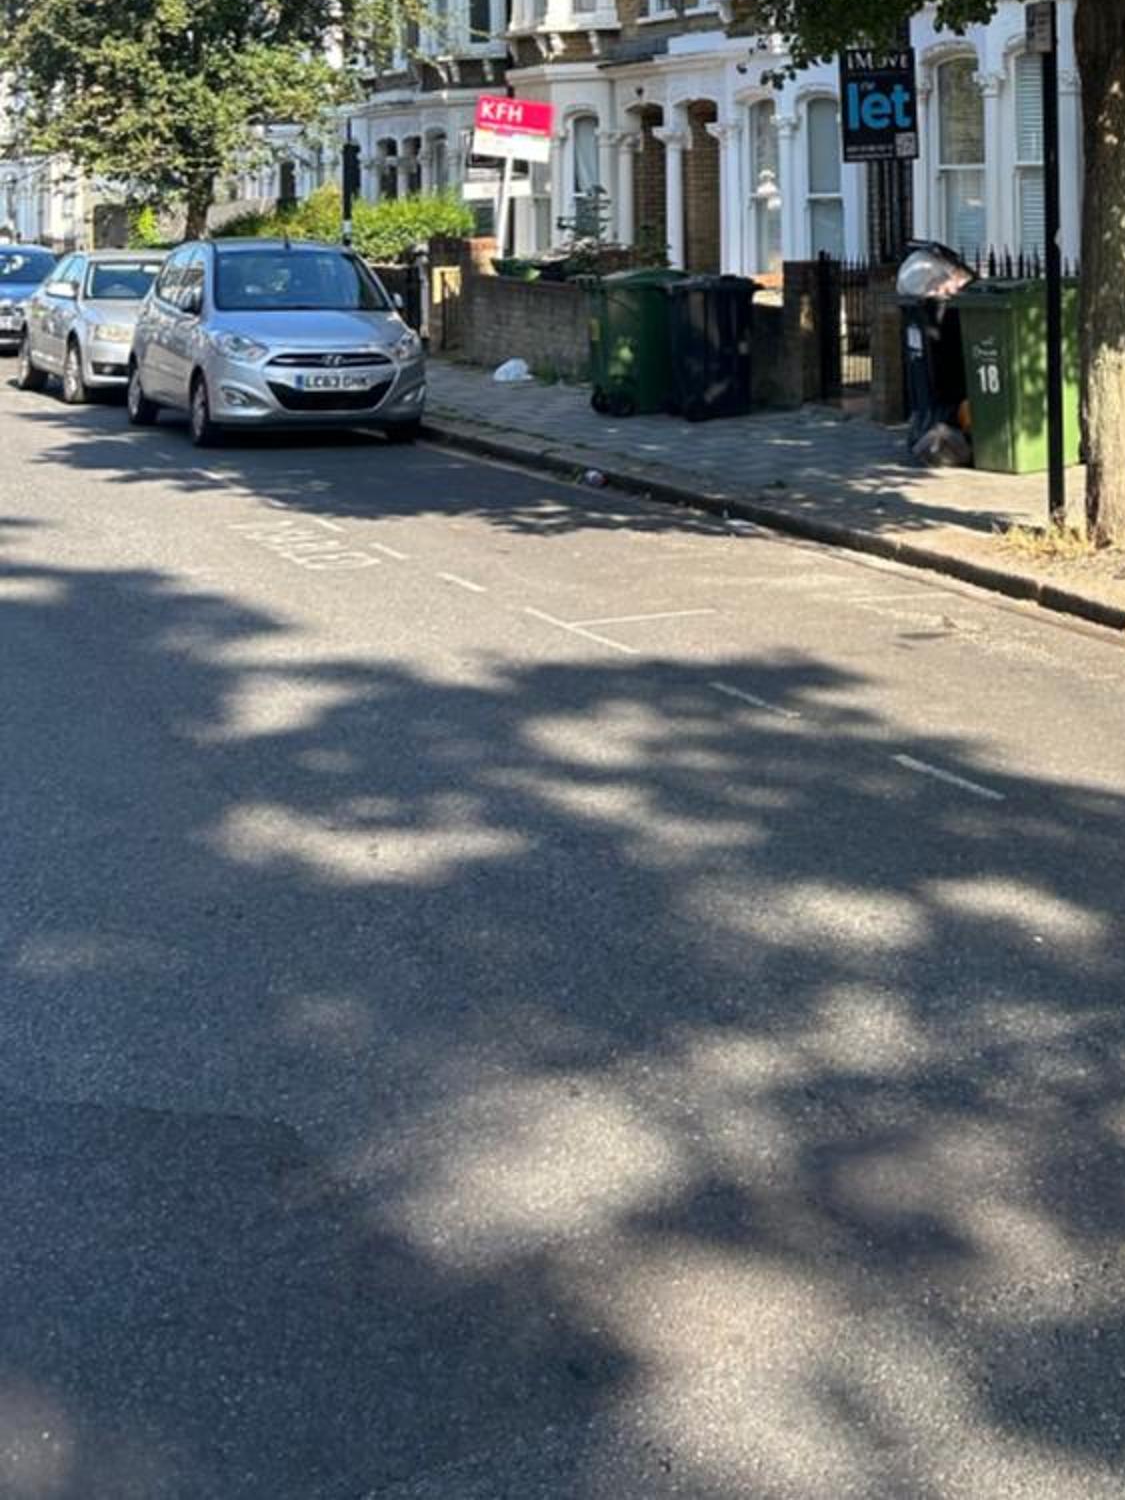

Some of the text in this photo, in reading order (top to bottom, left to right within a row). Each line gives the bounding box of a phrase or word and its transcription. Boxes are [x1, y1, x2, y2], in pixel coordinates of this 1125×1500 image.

[481, 100, 523, 123] KFH
[847, 83, 912, 130] let
[977, 365, 1000, 393] 18
